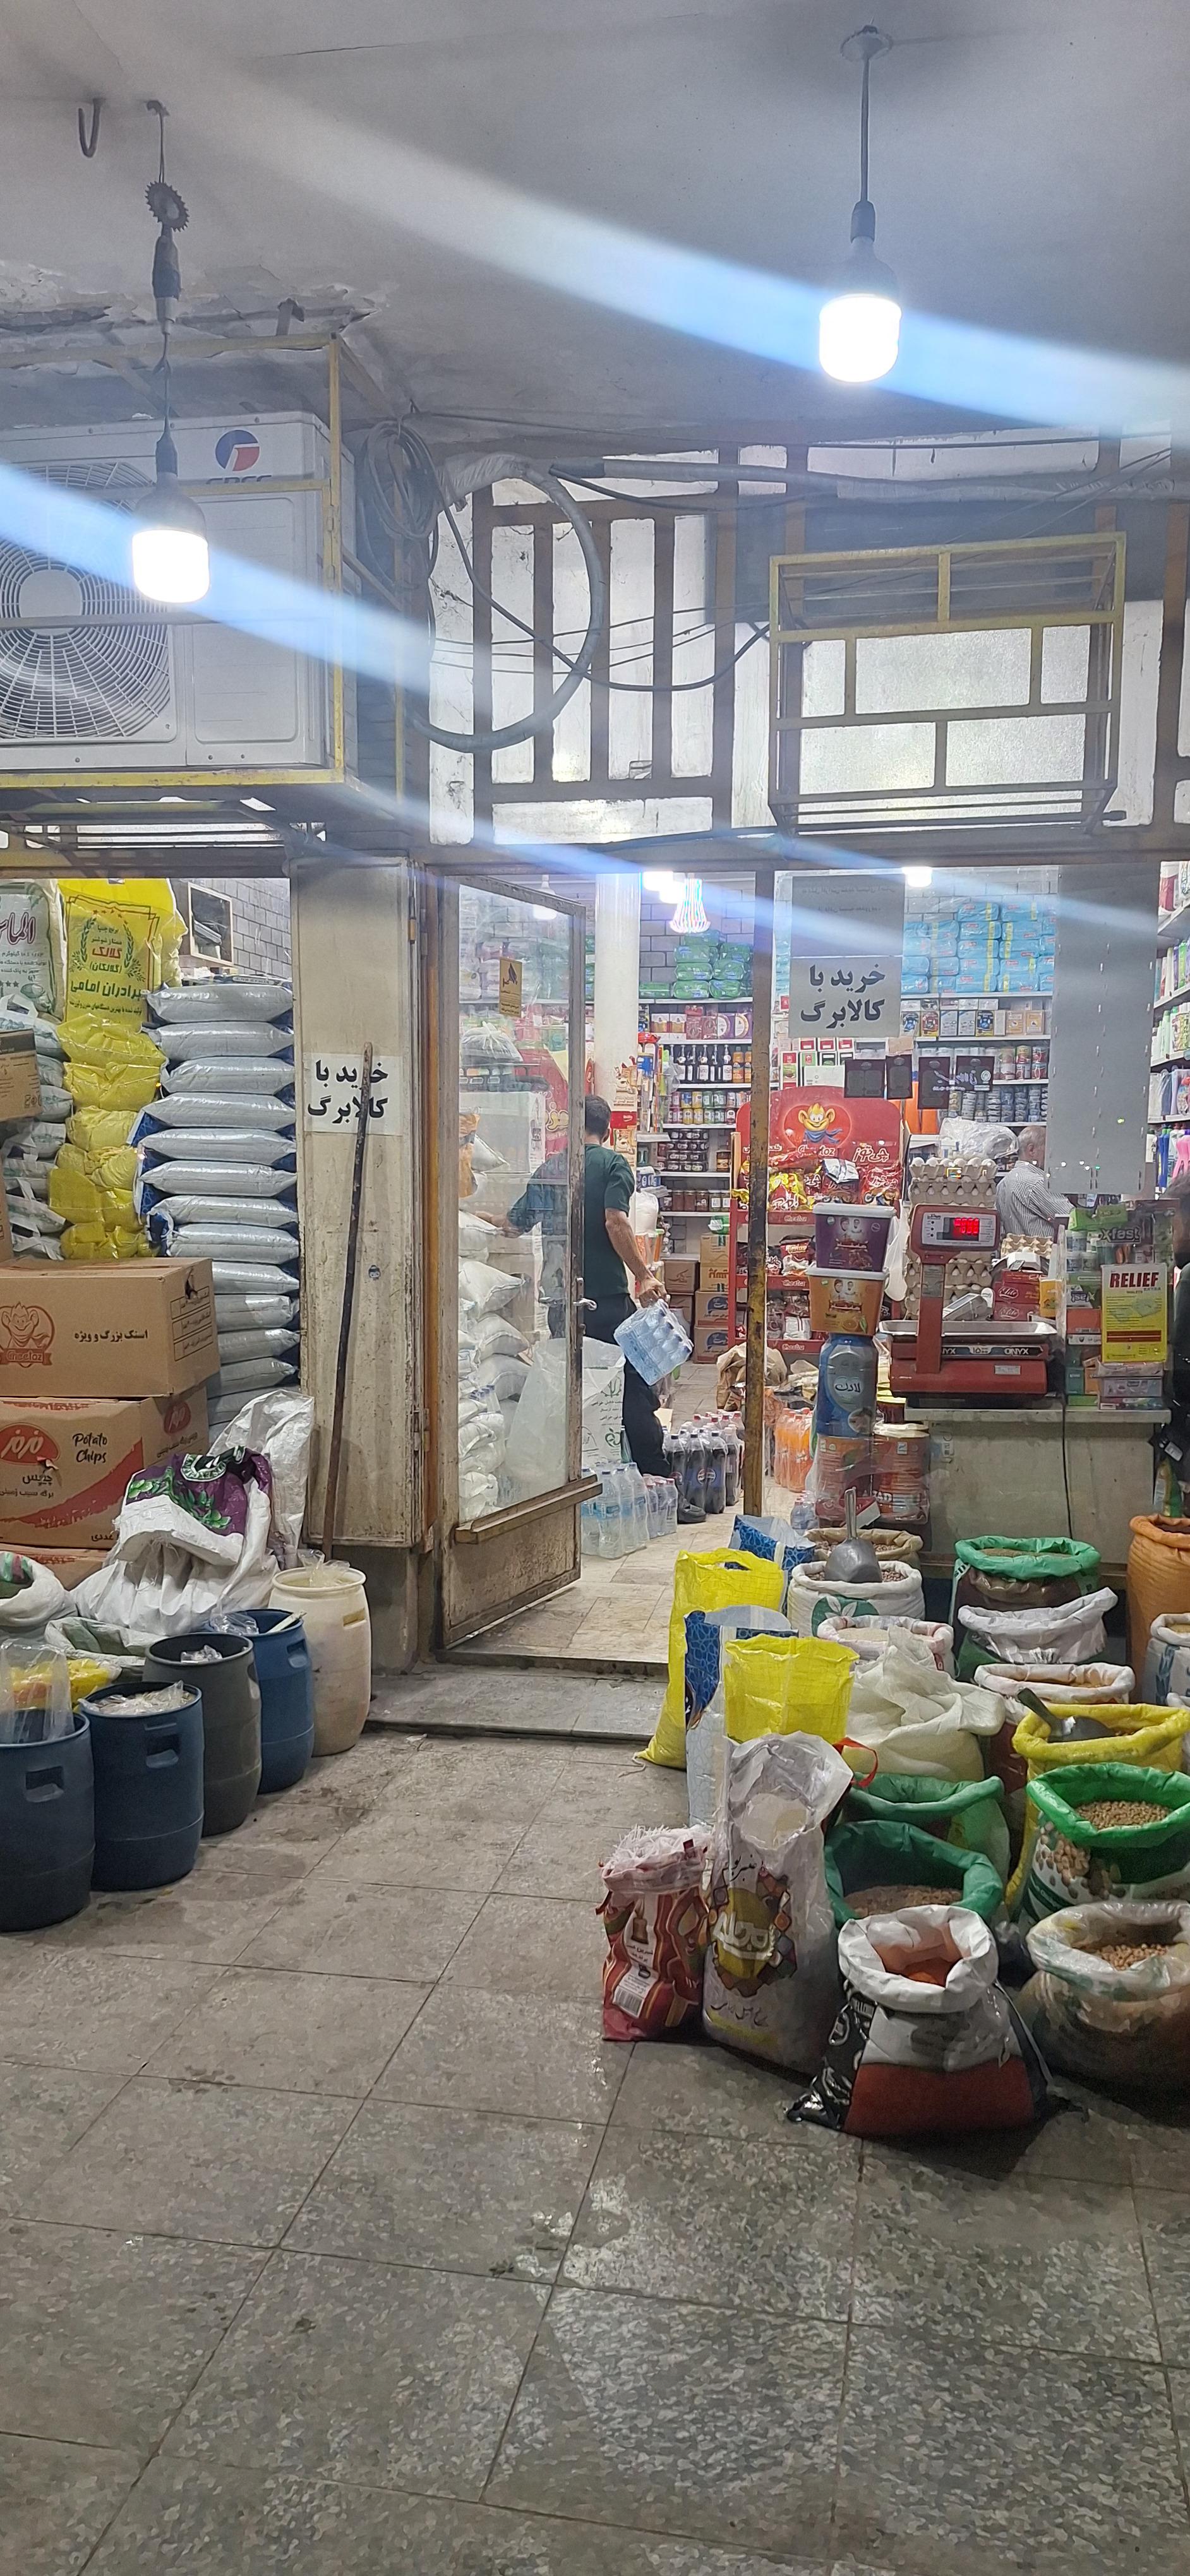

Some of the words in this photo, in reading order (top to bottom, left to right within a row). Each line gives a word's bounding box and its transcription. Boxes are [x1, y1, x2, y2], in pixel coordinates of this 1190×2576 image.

[70, 979, 101, 993] امامی
[809, 964, 824, 993] با
[830, 963, 886, 993] خرید
[800, 998, 886, 1029] کالابرگ
[315, 1059, 329, 1088] با
[335, 1062, 388, 1090] خید
[1109, 1272, 1160, 1288] RELIEF
[74, 1330, 92, 1343] ویژه
[93, 1333, 99, 1342] و
[100, 1329, 123, 1343] بزرگ
[124, 1329, 148, 1340] اسنک
[73, 1432, 108, 1448] Potato
[76, 1449, 107, 1464] Chips
